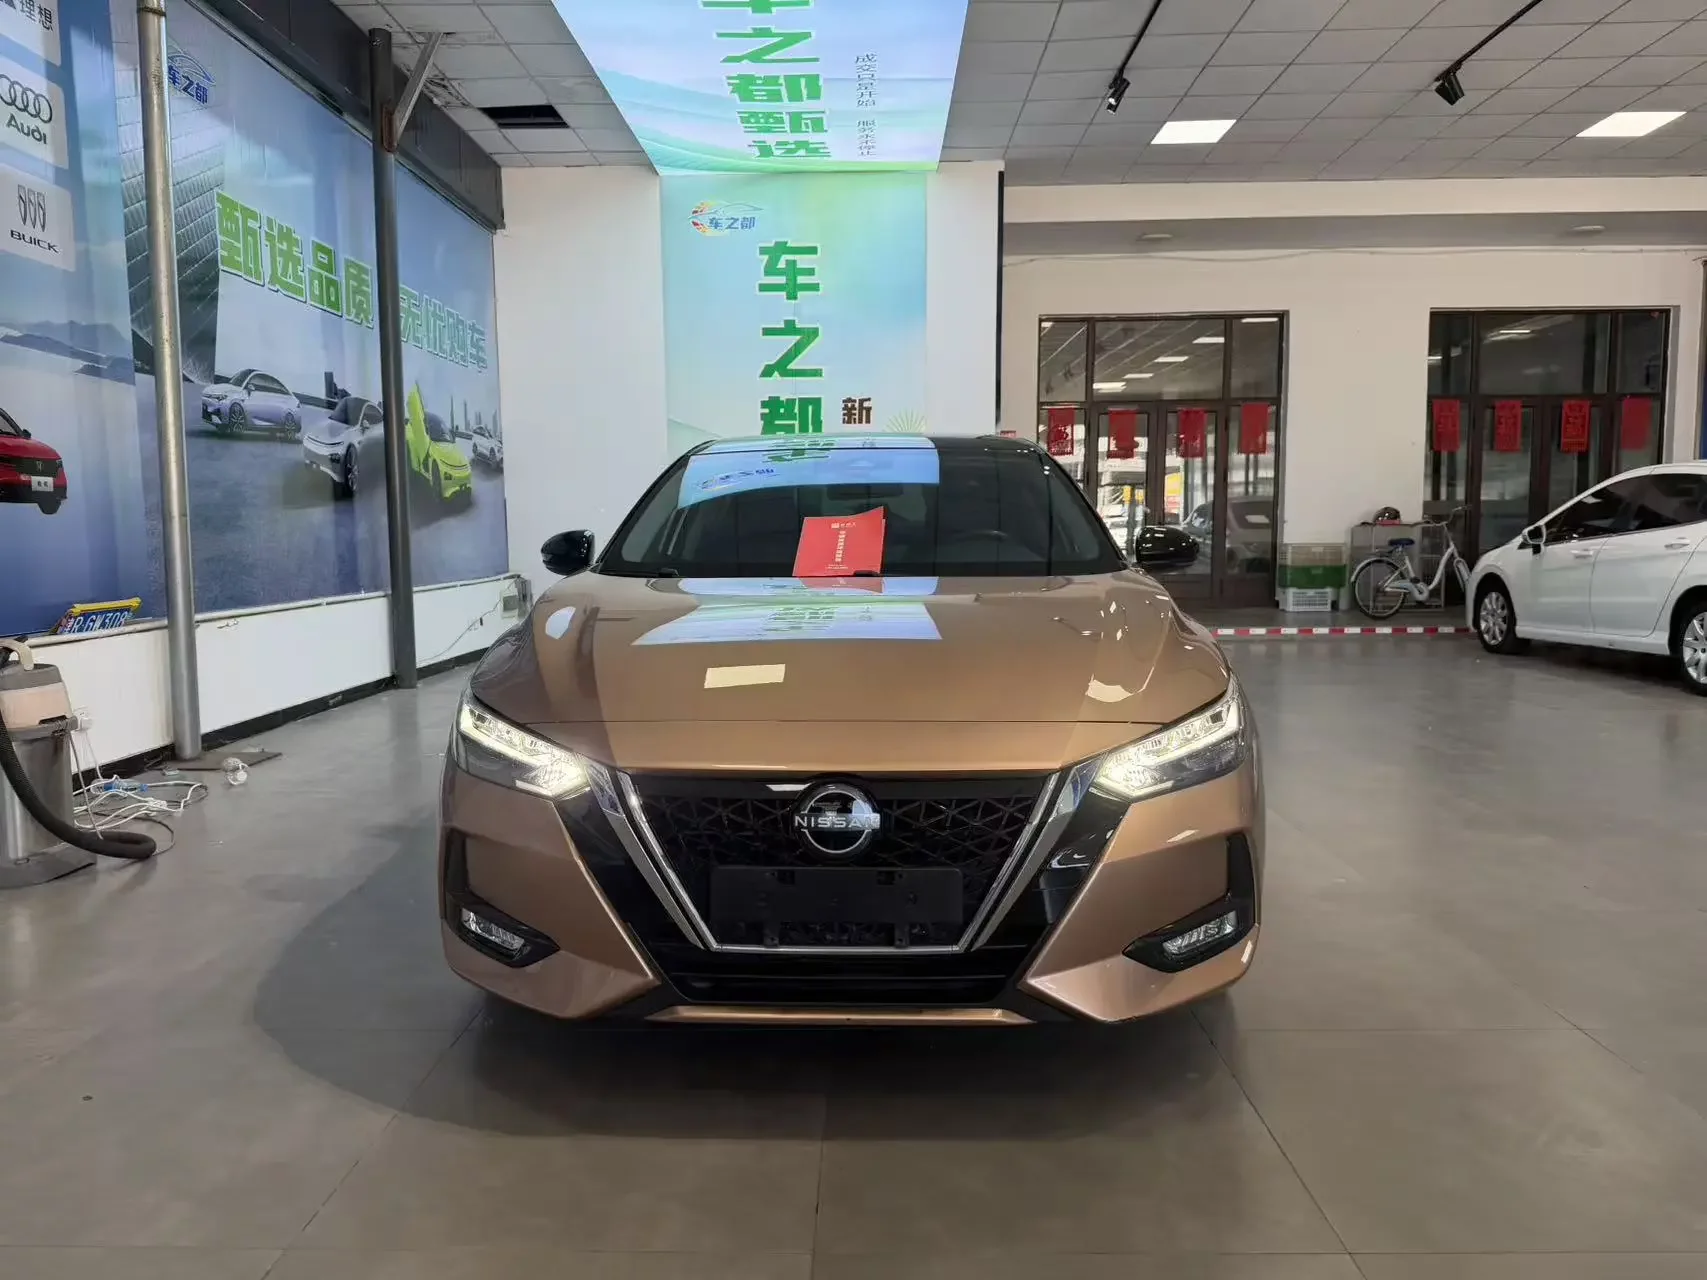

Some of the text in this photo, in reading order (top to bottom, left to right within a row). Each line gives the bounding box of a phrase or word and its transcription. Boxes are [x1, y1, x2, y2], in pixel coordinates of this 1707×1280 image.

[19, 0, 53, 31] 理想
[168, 65, 208, 104] 车之都
[6, 112, 47, 144] Audi
[708, 216, 756, 230] 车之都
[10, 229, 59, 253] BUICK
[215, 189, 373, 329] 甄选品质
[758, 240, 823, 435] 车之都
[842, 396, 872, 425] 新
